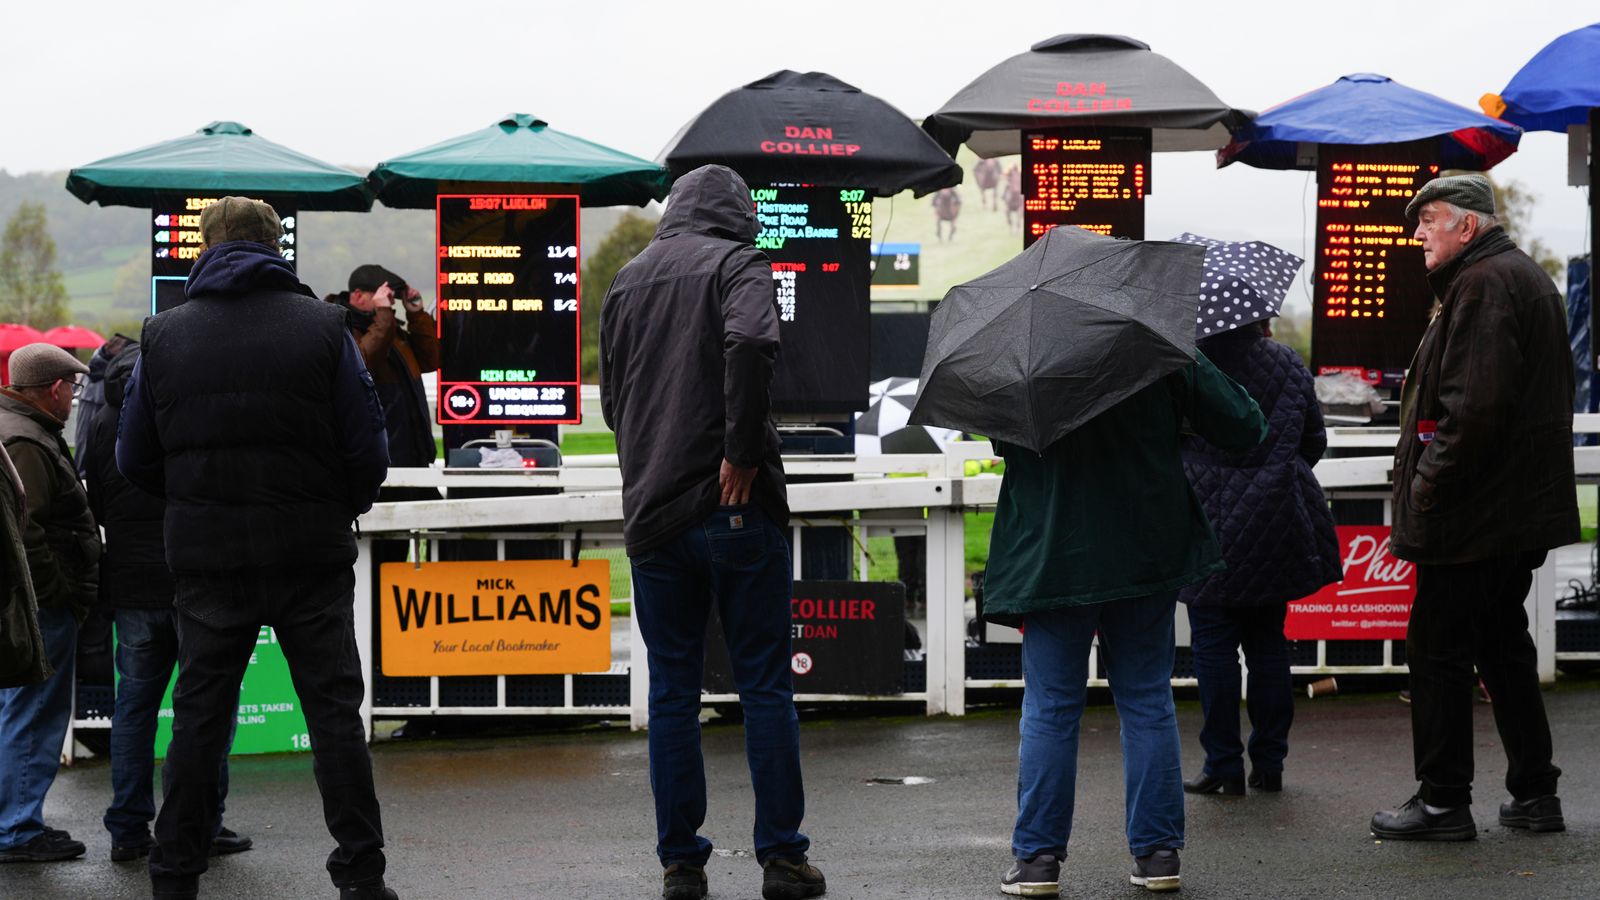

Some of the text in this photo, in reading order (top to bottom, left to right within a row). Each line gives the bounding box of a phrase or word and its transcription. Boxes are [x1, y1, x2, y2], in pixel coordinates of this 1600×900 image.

[1056, 81, 1106, 97] DAN
[1027, 98, 1132, 113] COLLIER
[785, 126, 832, 140] DAN
[760, 140, 861, 156] COLLIER
[840, 190, 865, 202] 3:07
[469, 198, 547, 209] 15:07 LUDLOW
[845, 202, 871, 214] 11/8
[852, 214, 871, 226] 7/4
[852, 226, 871, 238] 5/2
[448, 246, 521, 258] HISTRIONIC
[547, 246, 577, 258] 11/8
[448, 272, 479, 284] PIKE
[484, 272, 514, 284] ROAD
[553, 272, 577, 284] 7/4
[776, 287, 796, 297] 11/4
[477, 299, 507, 311] DELA
[553, 299, 577, 311] 5/2
[781, 304, 796, 313] 7/2
[480, 370, 536, 381] WIN ONLY
[488, 387, 565, 400] UNDER 25?
[488, 404, 566, 416] ID REQUIRED
[1342, 535, 1413, 582] Phil
[477, 578, 515, 590] MICK
[392, 583, 601, 632] WILLIAMS
[1290, 604, 1408, 613] TRADING AS CASHDOWN
[433, 639, 560, 653] Your Local Bookmaker
[261, 703, 293, 712] TAKEN
